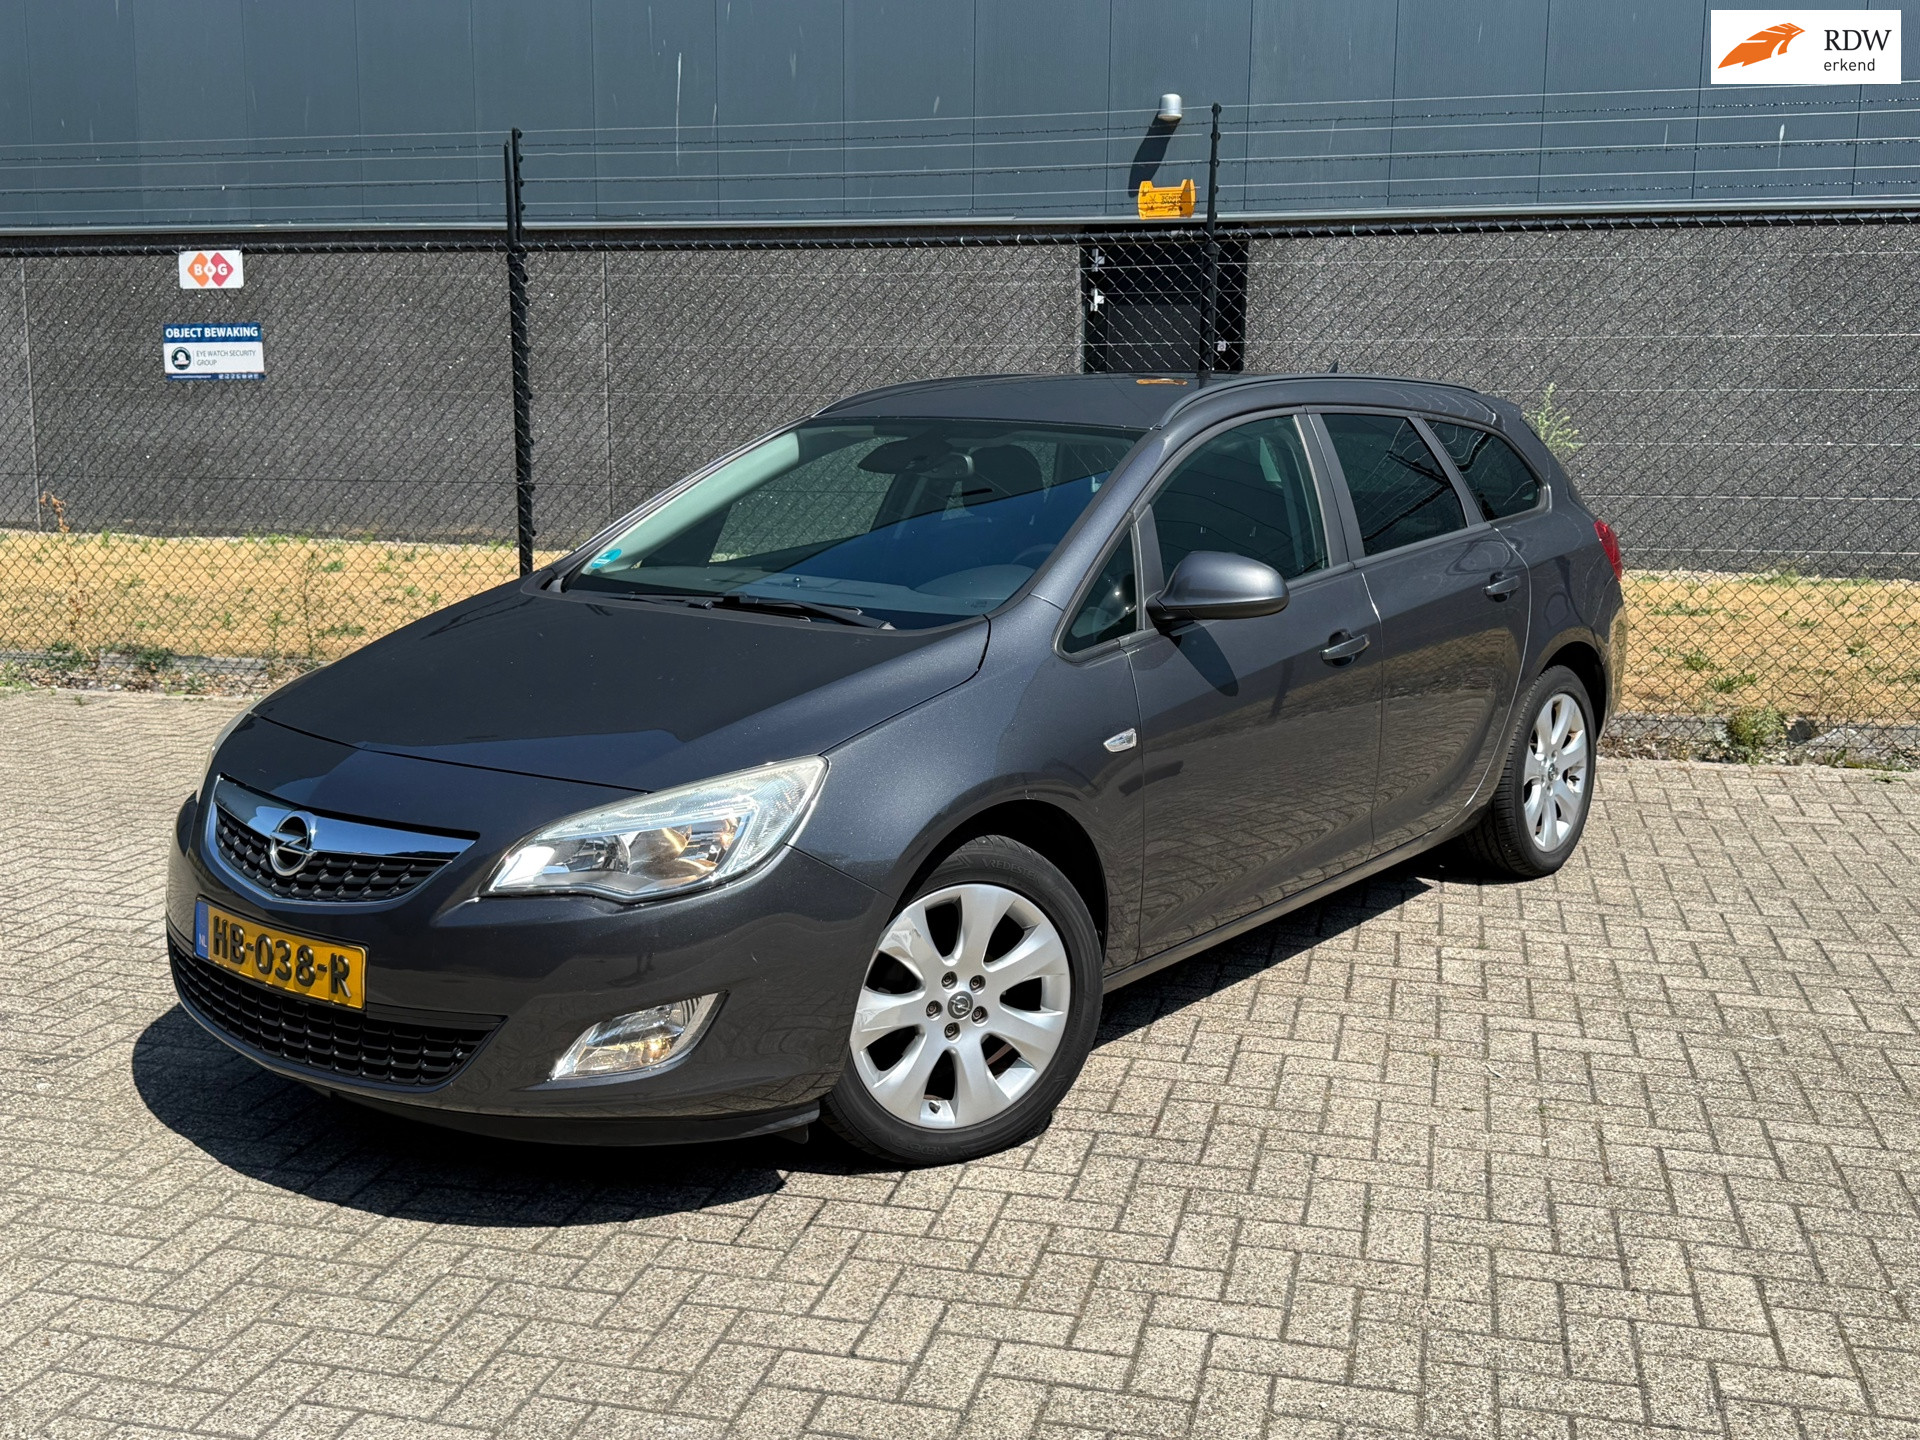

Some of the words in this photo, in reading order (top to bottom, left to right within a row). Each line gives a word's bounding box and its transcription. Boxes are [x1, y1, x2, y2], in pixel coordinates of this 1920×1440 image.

[165, 328, 203, 338] OBJECT
[204, 327, 259, 338] BEWAKING
[199, 933, 208, 948] NL
[213, 916, 352, 998] HB-038-R
